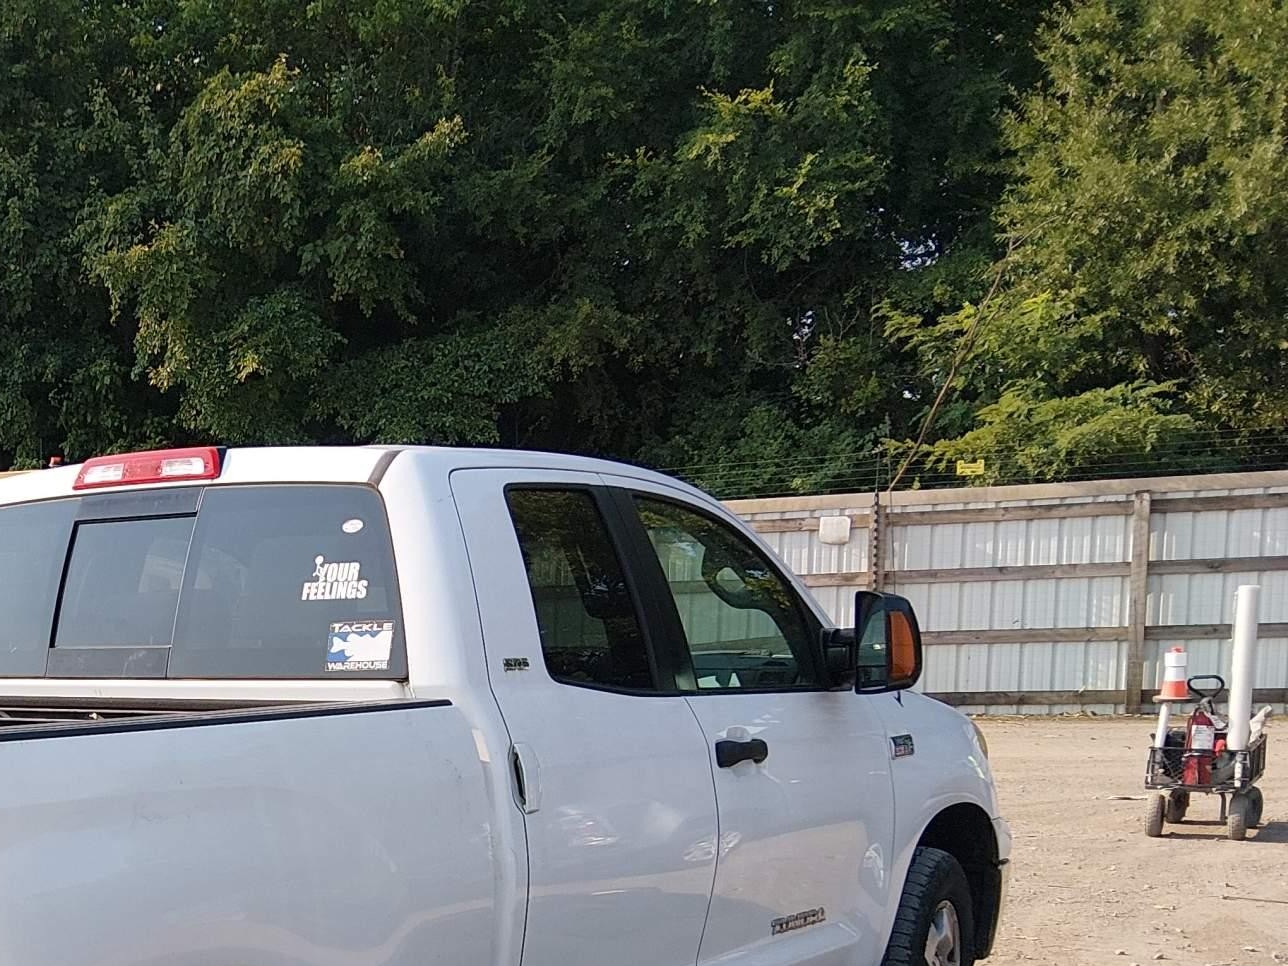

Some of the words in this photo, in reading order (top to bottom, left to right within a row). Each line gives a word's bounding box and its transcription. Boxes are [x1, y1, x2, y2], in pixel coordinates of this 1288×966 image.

[319, 562, 360, 583] YOUR
[302, 580, 368, 601] FEELINGS
[332, 622, 394, 633] TACKLE
[328, 661, 388, 670] WAREHOUSE
